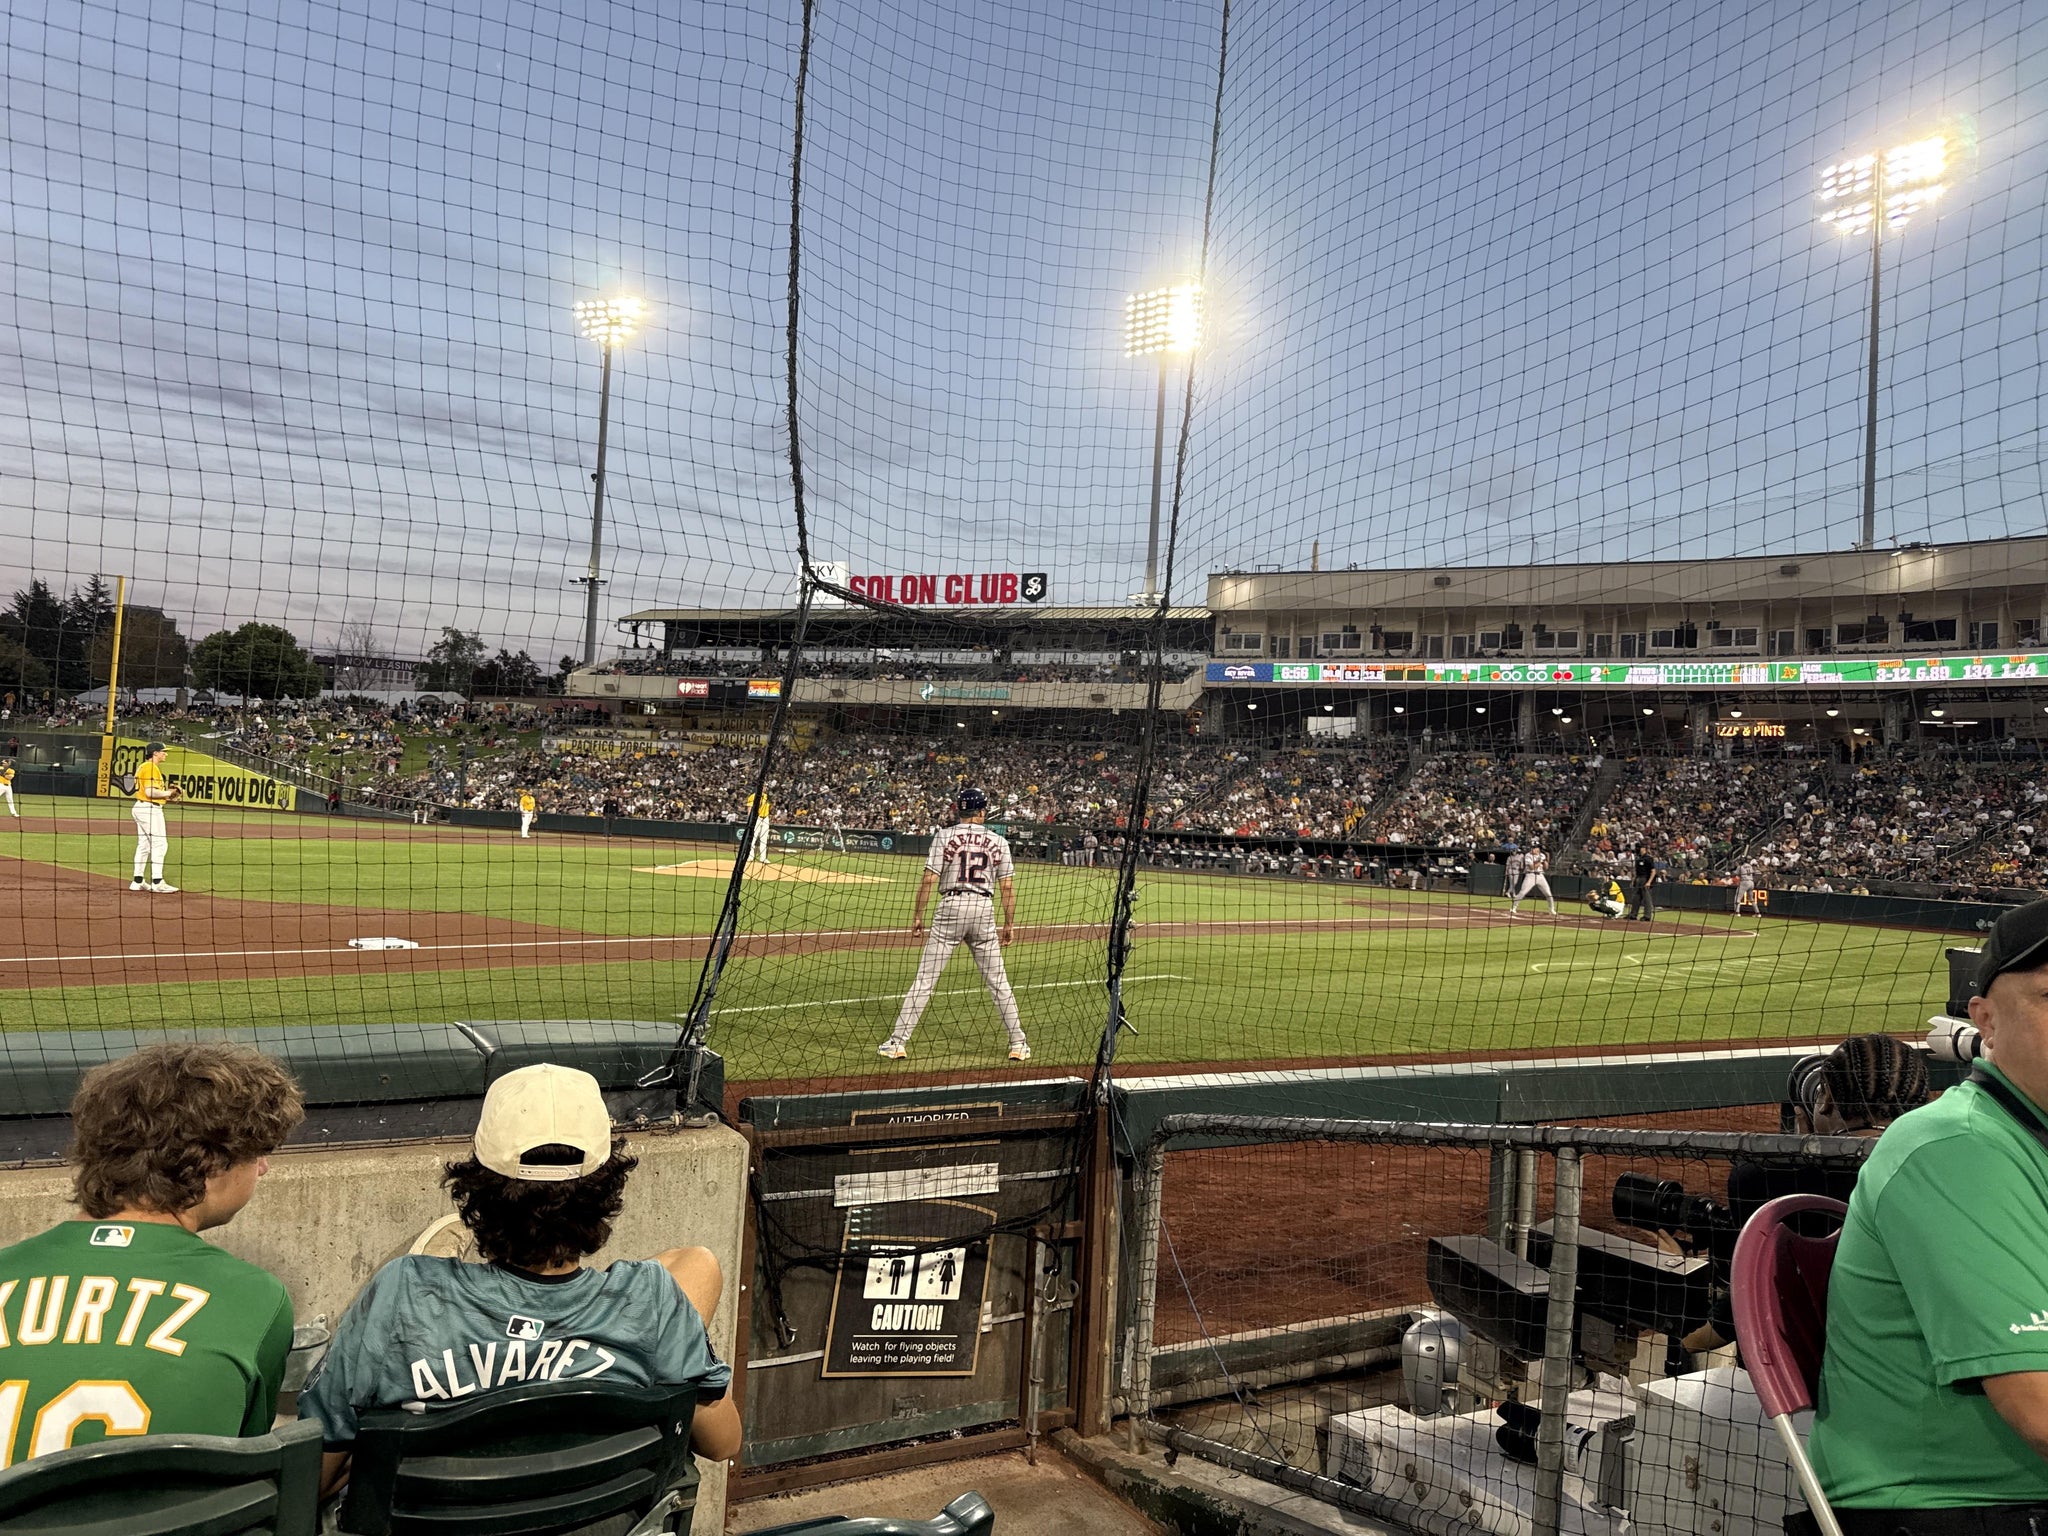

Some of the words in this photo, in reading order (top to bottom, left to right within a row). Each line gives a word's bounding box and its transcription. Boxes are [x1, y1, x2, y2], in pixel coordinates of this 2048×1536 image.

[850, 575, 937, 605] SOLON
[945, 573, 1018, 604] CLUB
[345, 657, 372, 667] NOW
[1590, 667, 1602, 682] 2
[1963, 664, 1993, 678] 134
[1742, 726, 1751, 737] &
[1753, 725, 1786, 737] PINTS
[571, 740, 614, 753] PACIFICO
[113, 746, 147, 777] 811
[162, 774, 214, 800] EFORE
[217, 777, 246, 802] YOU
[249, 778, 276, 805] DIG
[957, 850, 989, 884] 12
[871, 1303, 944, 1331] CAUTION!
[851, 1342, 880, 1351] Watch
[884, 1341, 897, 1351] for
[899, 1341, 924, 1353] flying
[925, 1341, 957, 1353] objects
[849, 1354, 882, 1365] leaving
[884, 1354, 899, 1363] the
[900, 1354, 932, 1365] playing
[933, 1353, 955, 1363] field!
[411, 1339, 617, 1400] ALVAREZ
